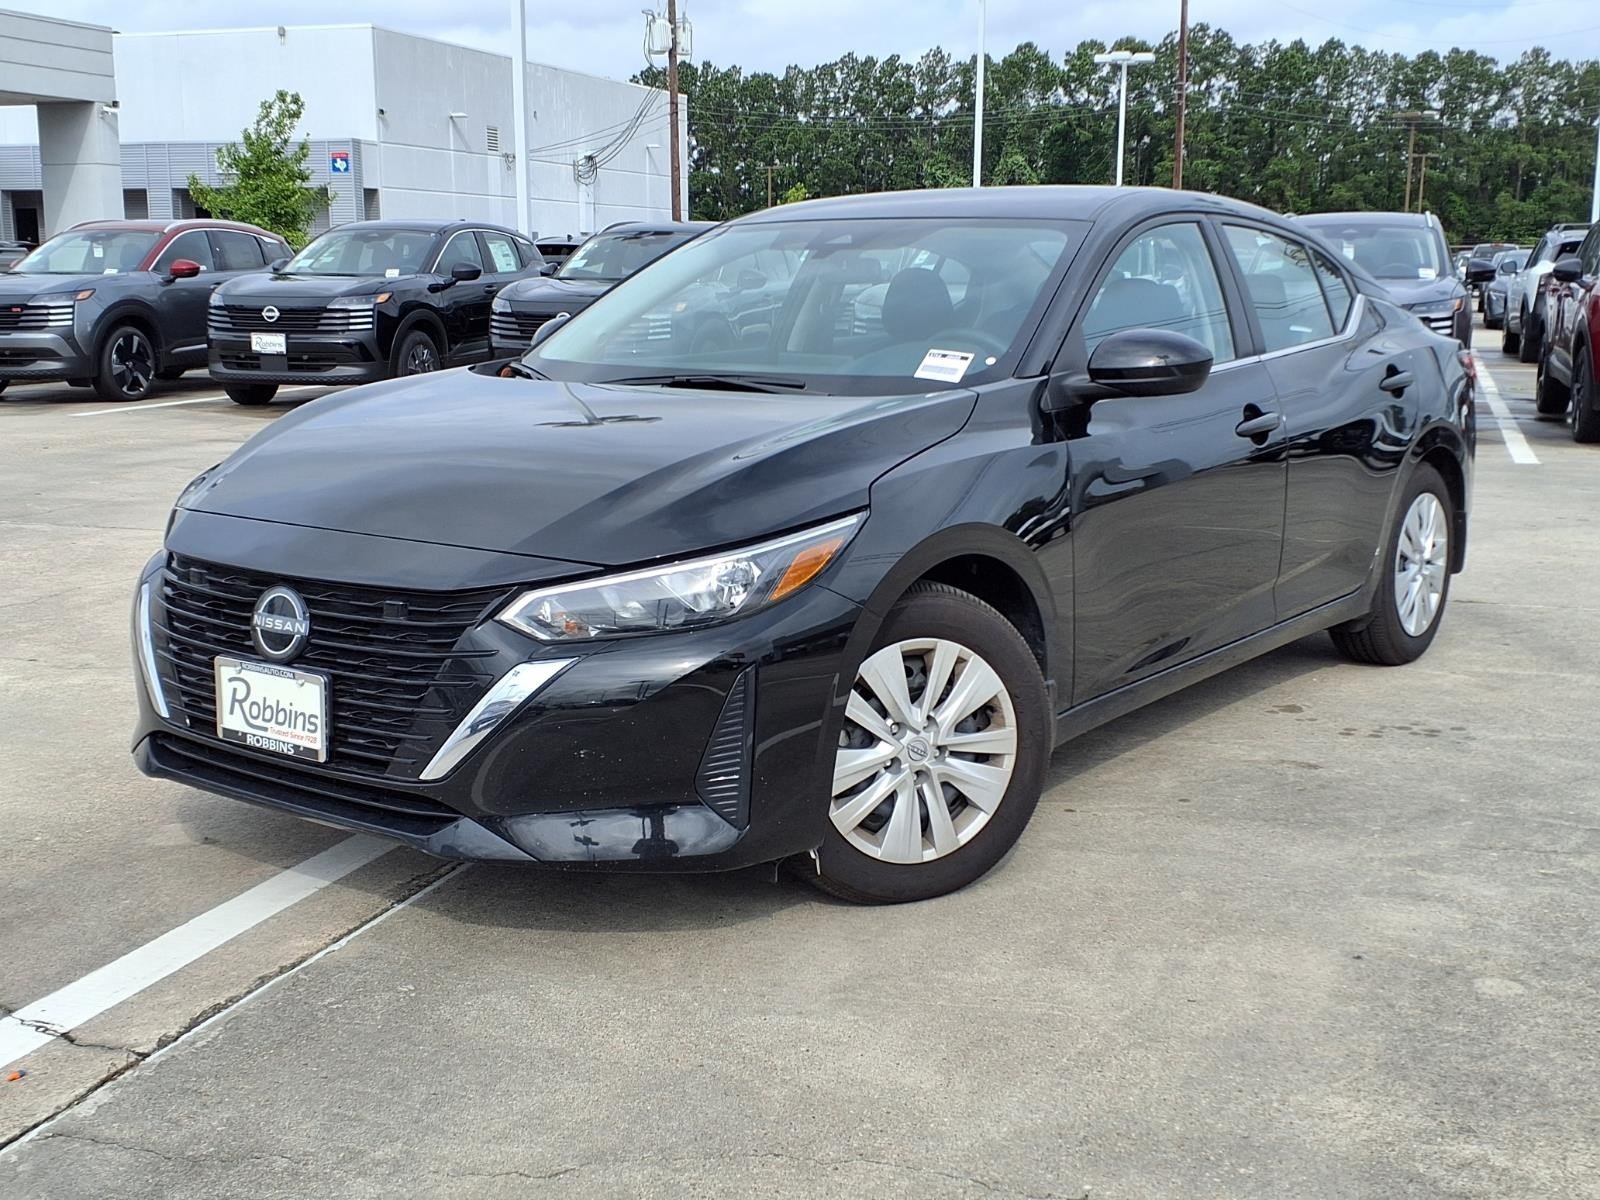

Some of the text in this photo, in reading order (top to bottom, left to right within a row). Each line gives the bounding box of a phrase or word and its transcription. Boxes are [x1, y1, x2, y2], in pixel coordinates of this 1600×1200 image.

[253, 614, 306, 634] NISSAN
[227, 676, 319, 735] Robbins
[269, 727, 289, 738] Trusted
[290, 731, 304, 741] Since
[246, 734, 295, 755] ROBBINS
